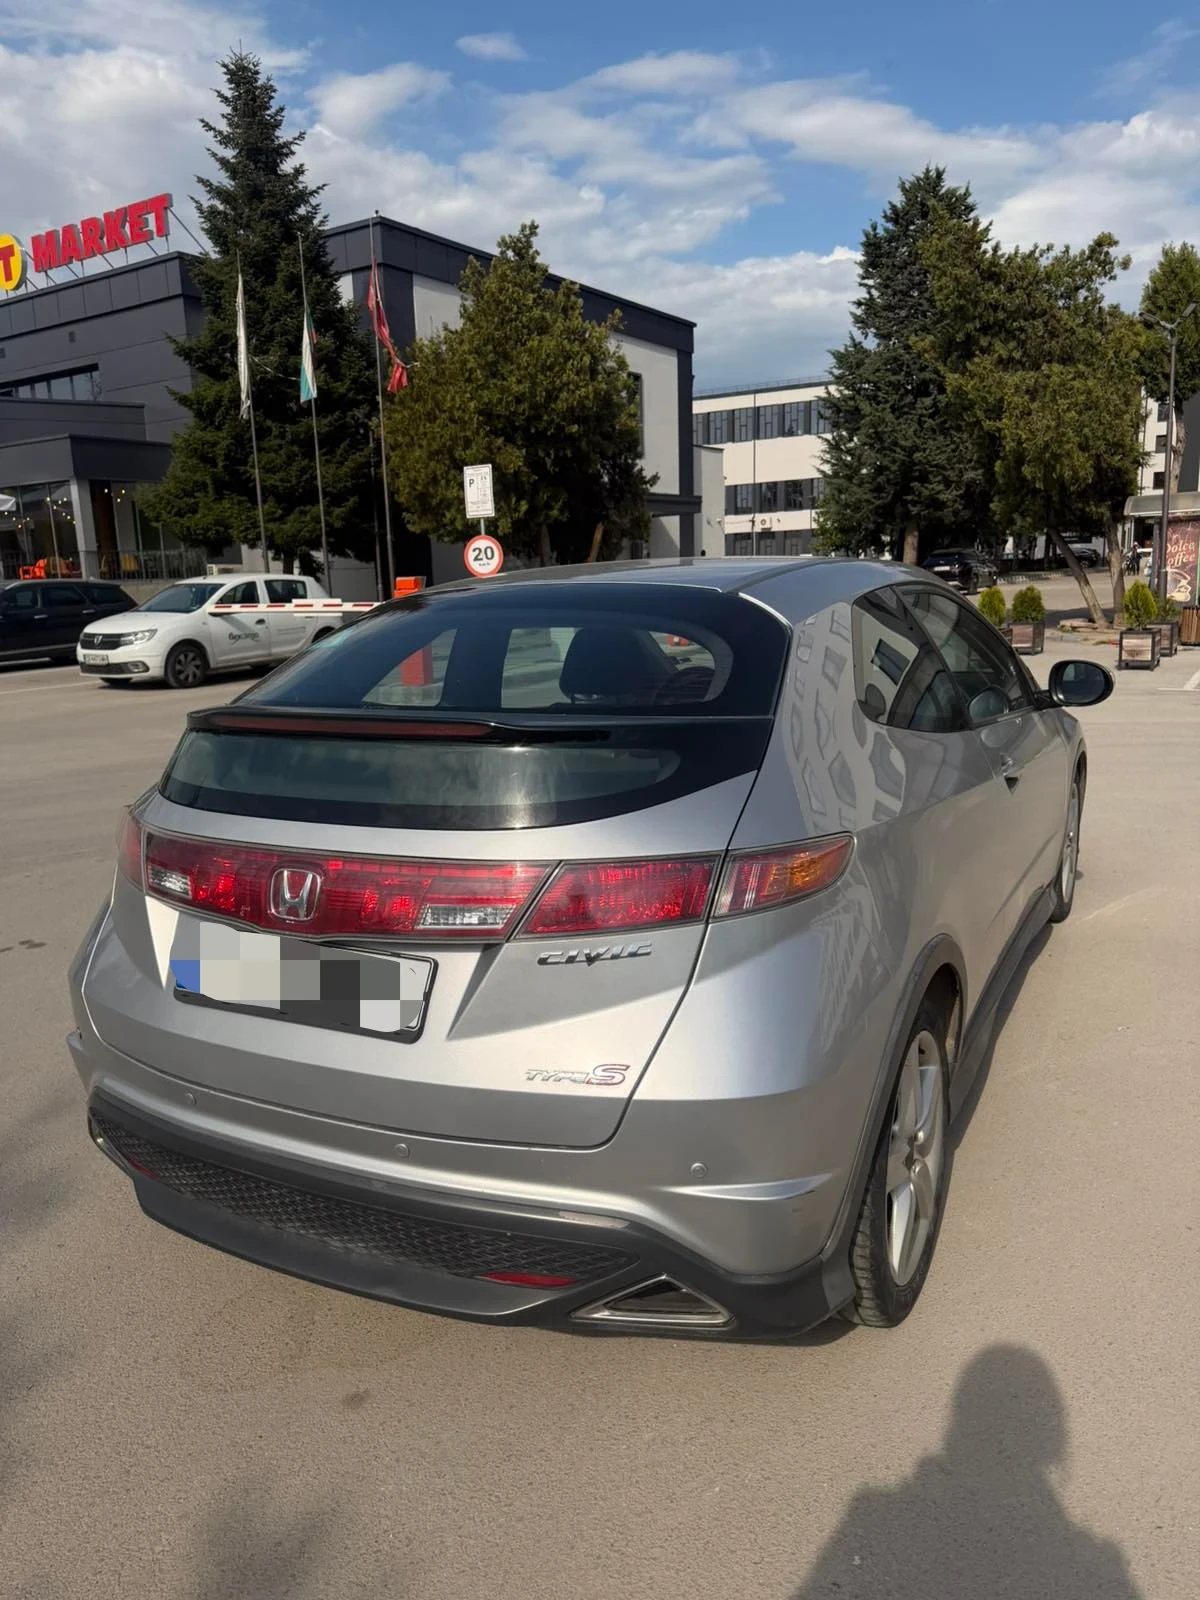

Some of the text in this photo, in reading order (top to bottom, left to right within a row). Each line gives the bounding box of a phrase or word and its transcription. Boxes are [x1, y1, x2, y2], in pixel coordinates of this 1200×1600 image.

[31, 193, 172, 273] MARKET
[472, 545, 495, 562] 20
[1166, 551, 1196, 568] offee
[537, 942, 652, 967] CIVIC
[524, 1063, 631, 1086] TYPE S
